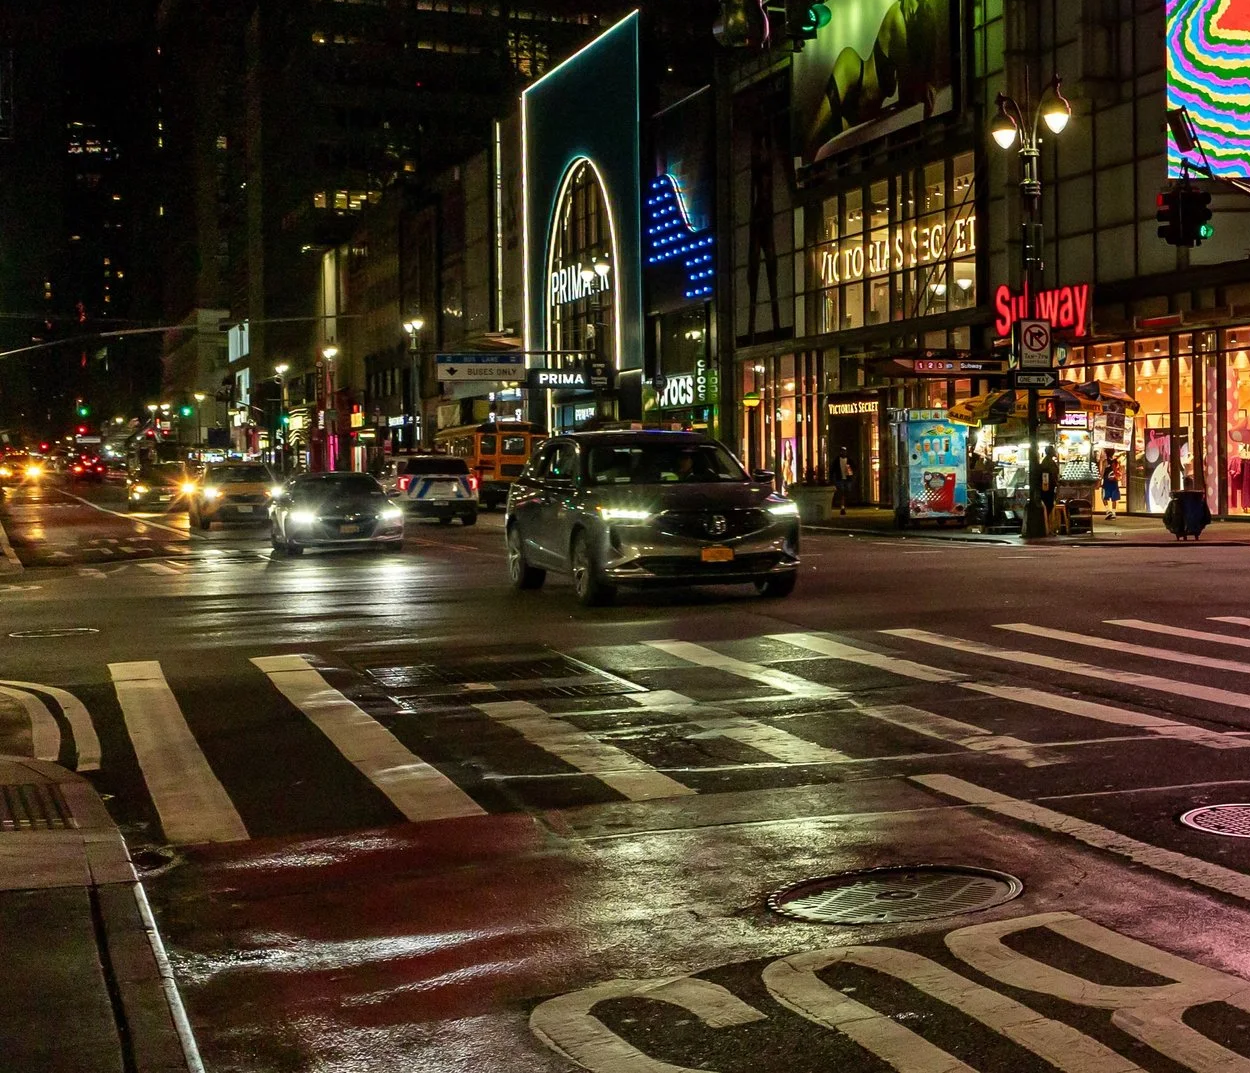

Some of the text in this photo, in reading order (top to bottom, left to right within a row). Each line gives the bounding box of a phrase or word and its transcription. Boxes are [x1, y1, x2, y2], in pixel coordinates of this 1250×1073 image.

[911, 216, 976, 262] SECET
[551, 262, 610, 306] PRIMAK
[467, 368, 517, 376] BUSES ONLY
[961, 362, 982, 370] Subway
[539, 374, 584, 385] PRIMA
[697, 360, 706, 401] crocs
[828, 401, 879, 415] VICTORIA'S SECRET
